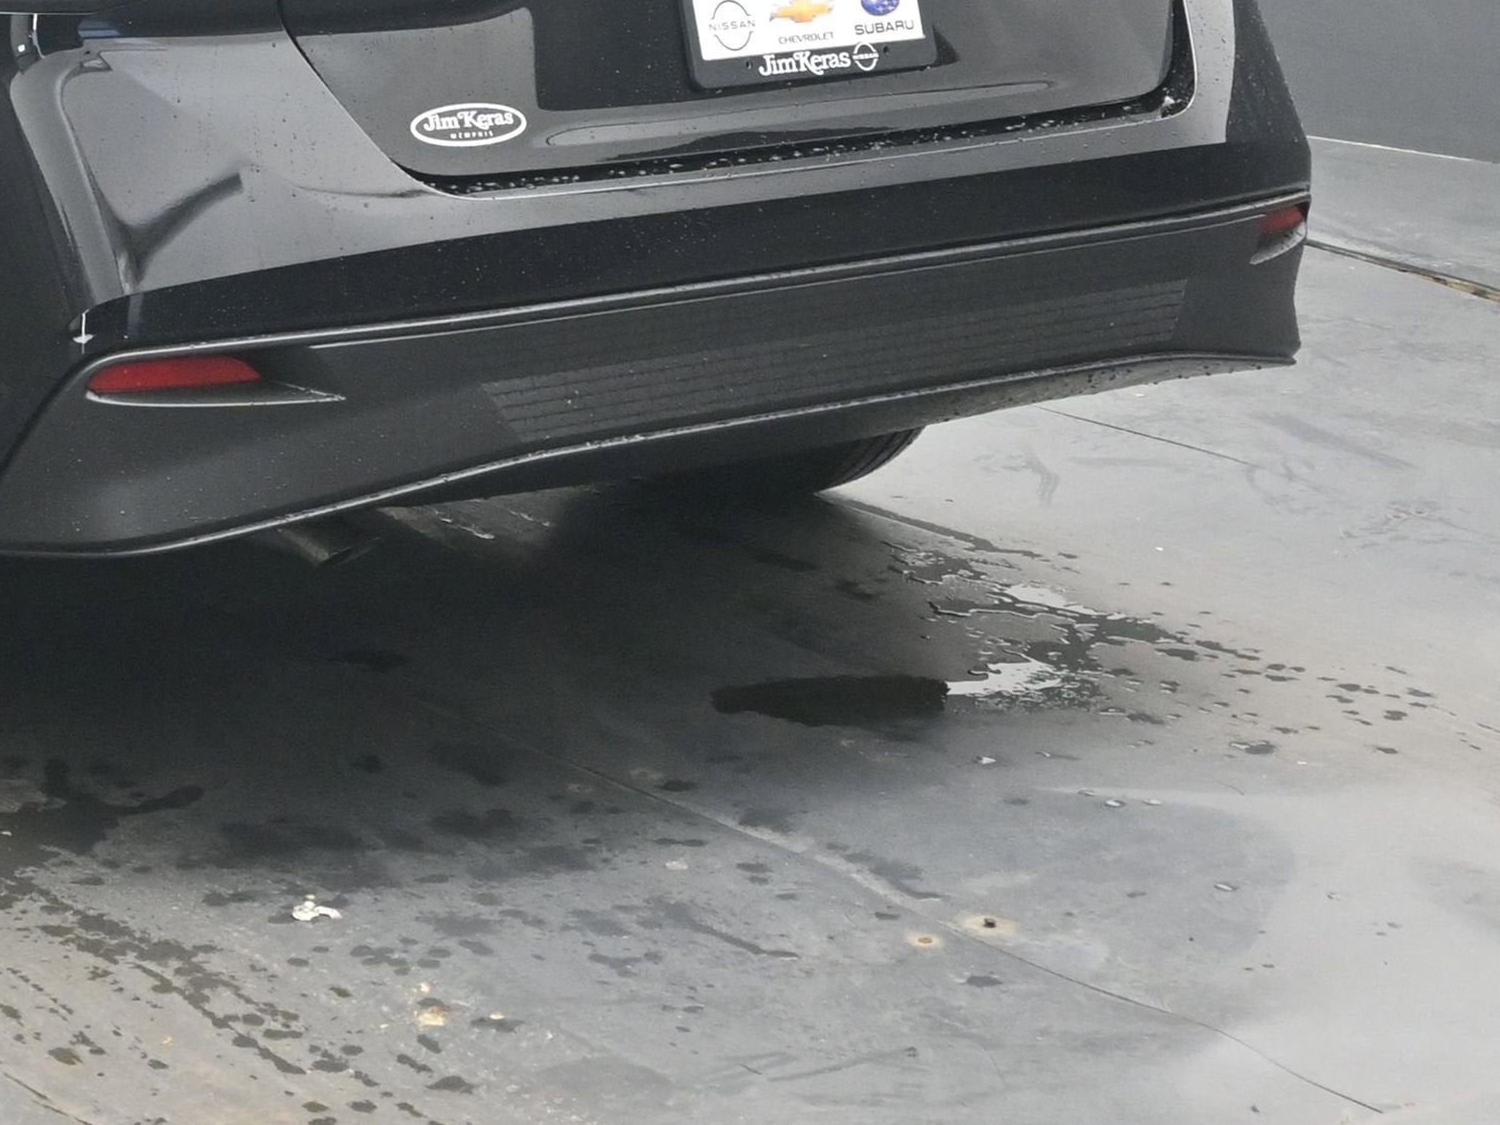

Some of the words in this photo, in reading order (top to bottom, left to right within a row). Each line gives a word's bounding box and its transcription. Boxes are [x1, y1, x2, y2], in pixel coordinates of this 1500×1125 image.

[708, 19, 756, 31] NISSAN
[854, 19, 915, 36] SUBARU
[778, 31, 835, 45] CHEVROLET
